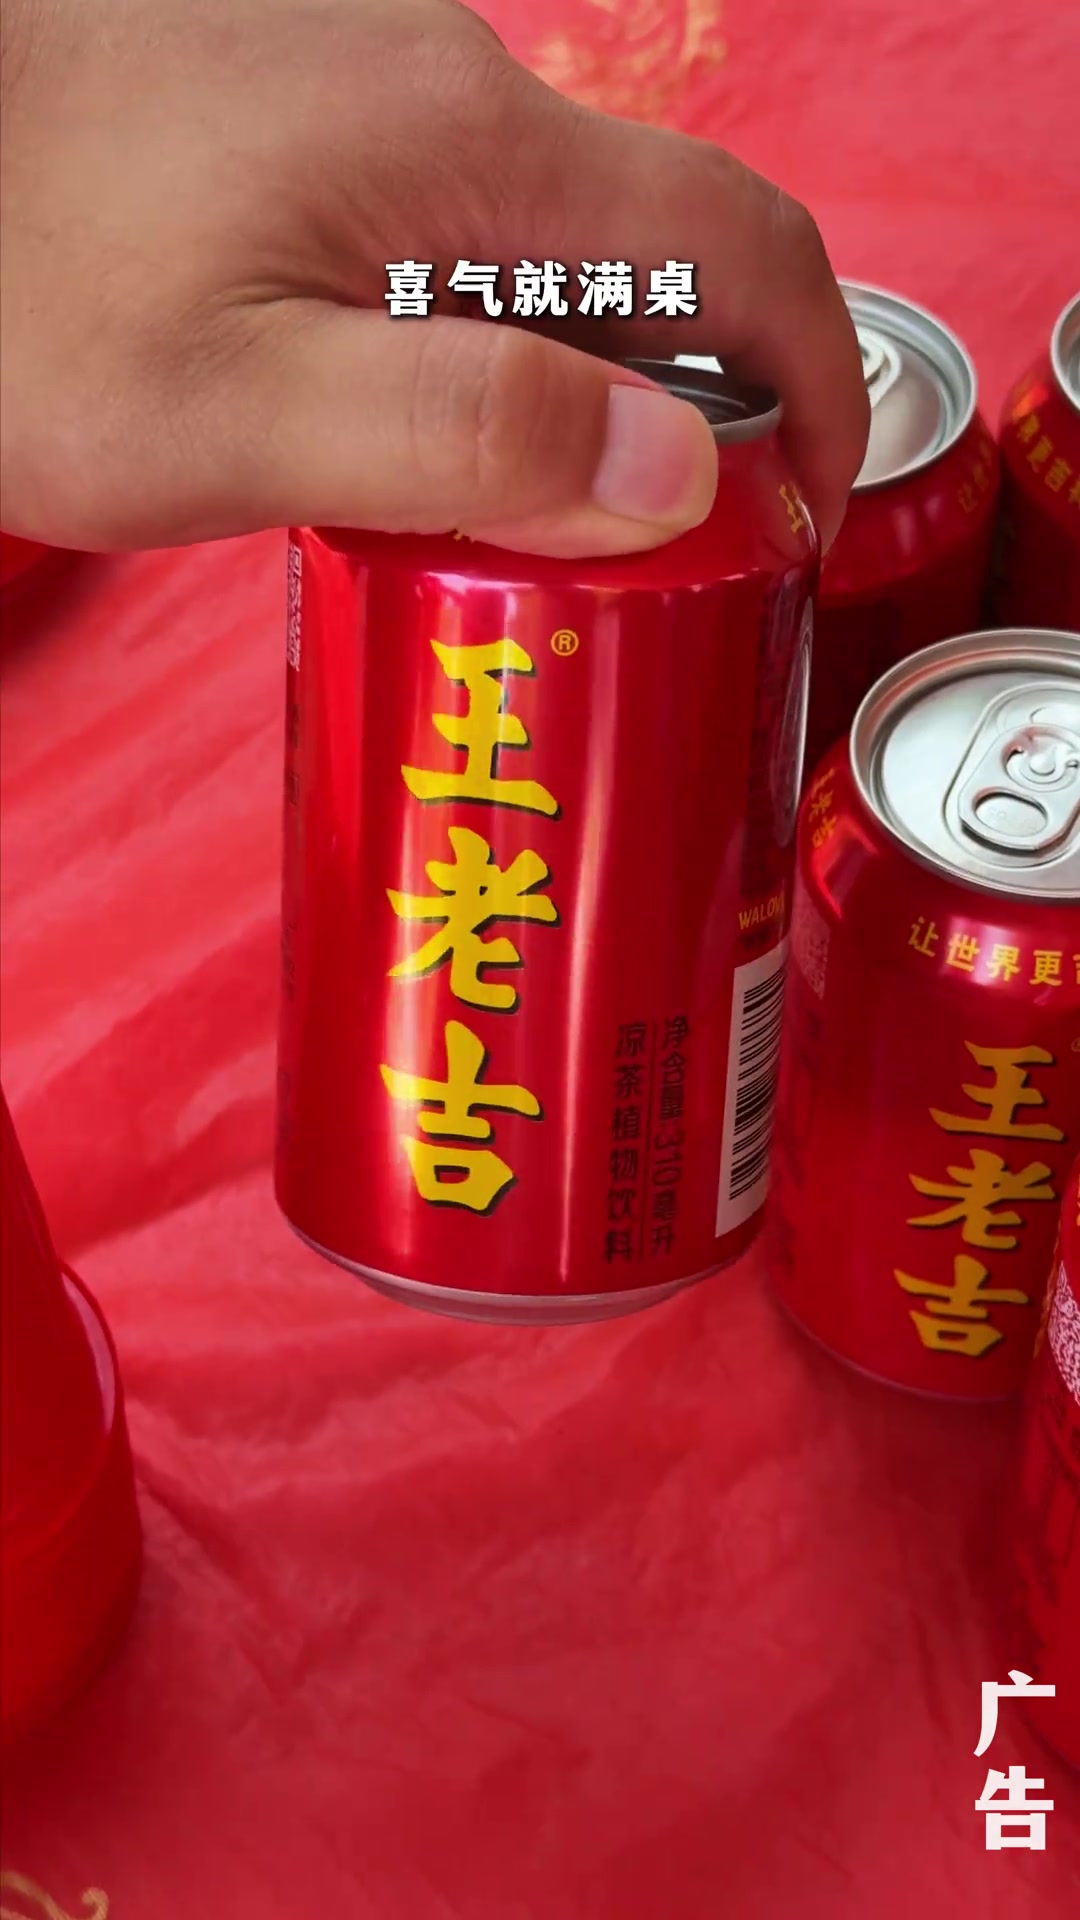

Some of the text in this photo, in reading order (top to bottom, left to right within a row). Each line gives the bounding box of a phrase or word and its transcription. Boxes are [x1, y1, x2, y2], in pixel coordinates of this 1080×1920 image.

[379, 638, 561, 1216] 王老吉
[606, 1022, 647, 1264] 凉茶植物饮料
[893, 1040, 1065, 1359] 王老吉
